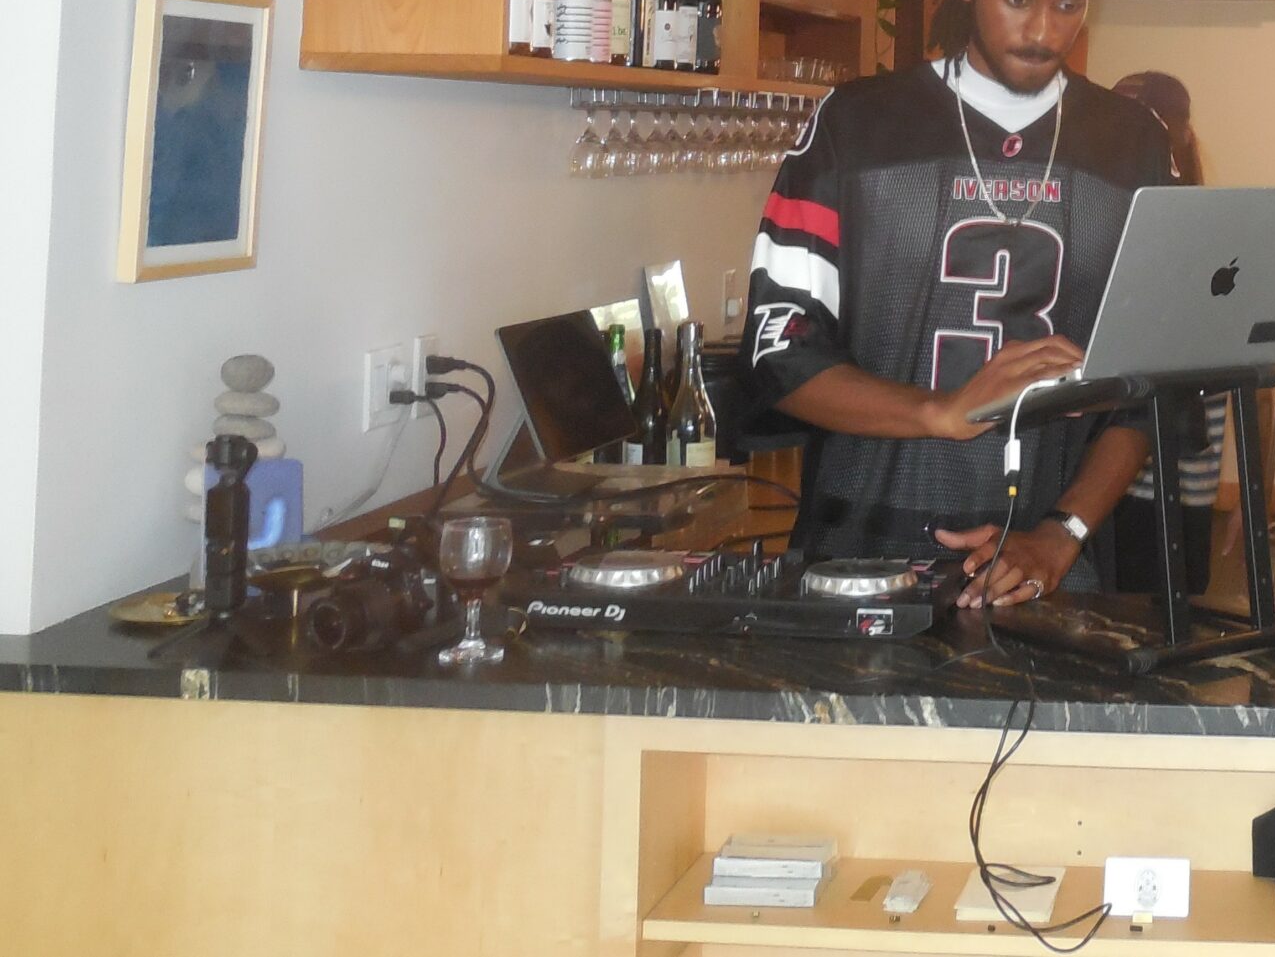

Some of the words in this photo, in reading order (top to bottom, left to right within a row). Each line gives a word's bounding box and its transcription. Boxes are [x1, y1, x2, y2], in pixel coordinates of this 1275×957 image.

[953, 177, 1062, 203] IVERSON
[930, 215, 1065, 391] 3
[527, 600, 601, 617] Pioneer
